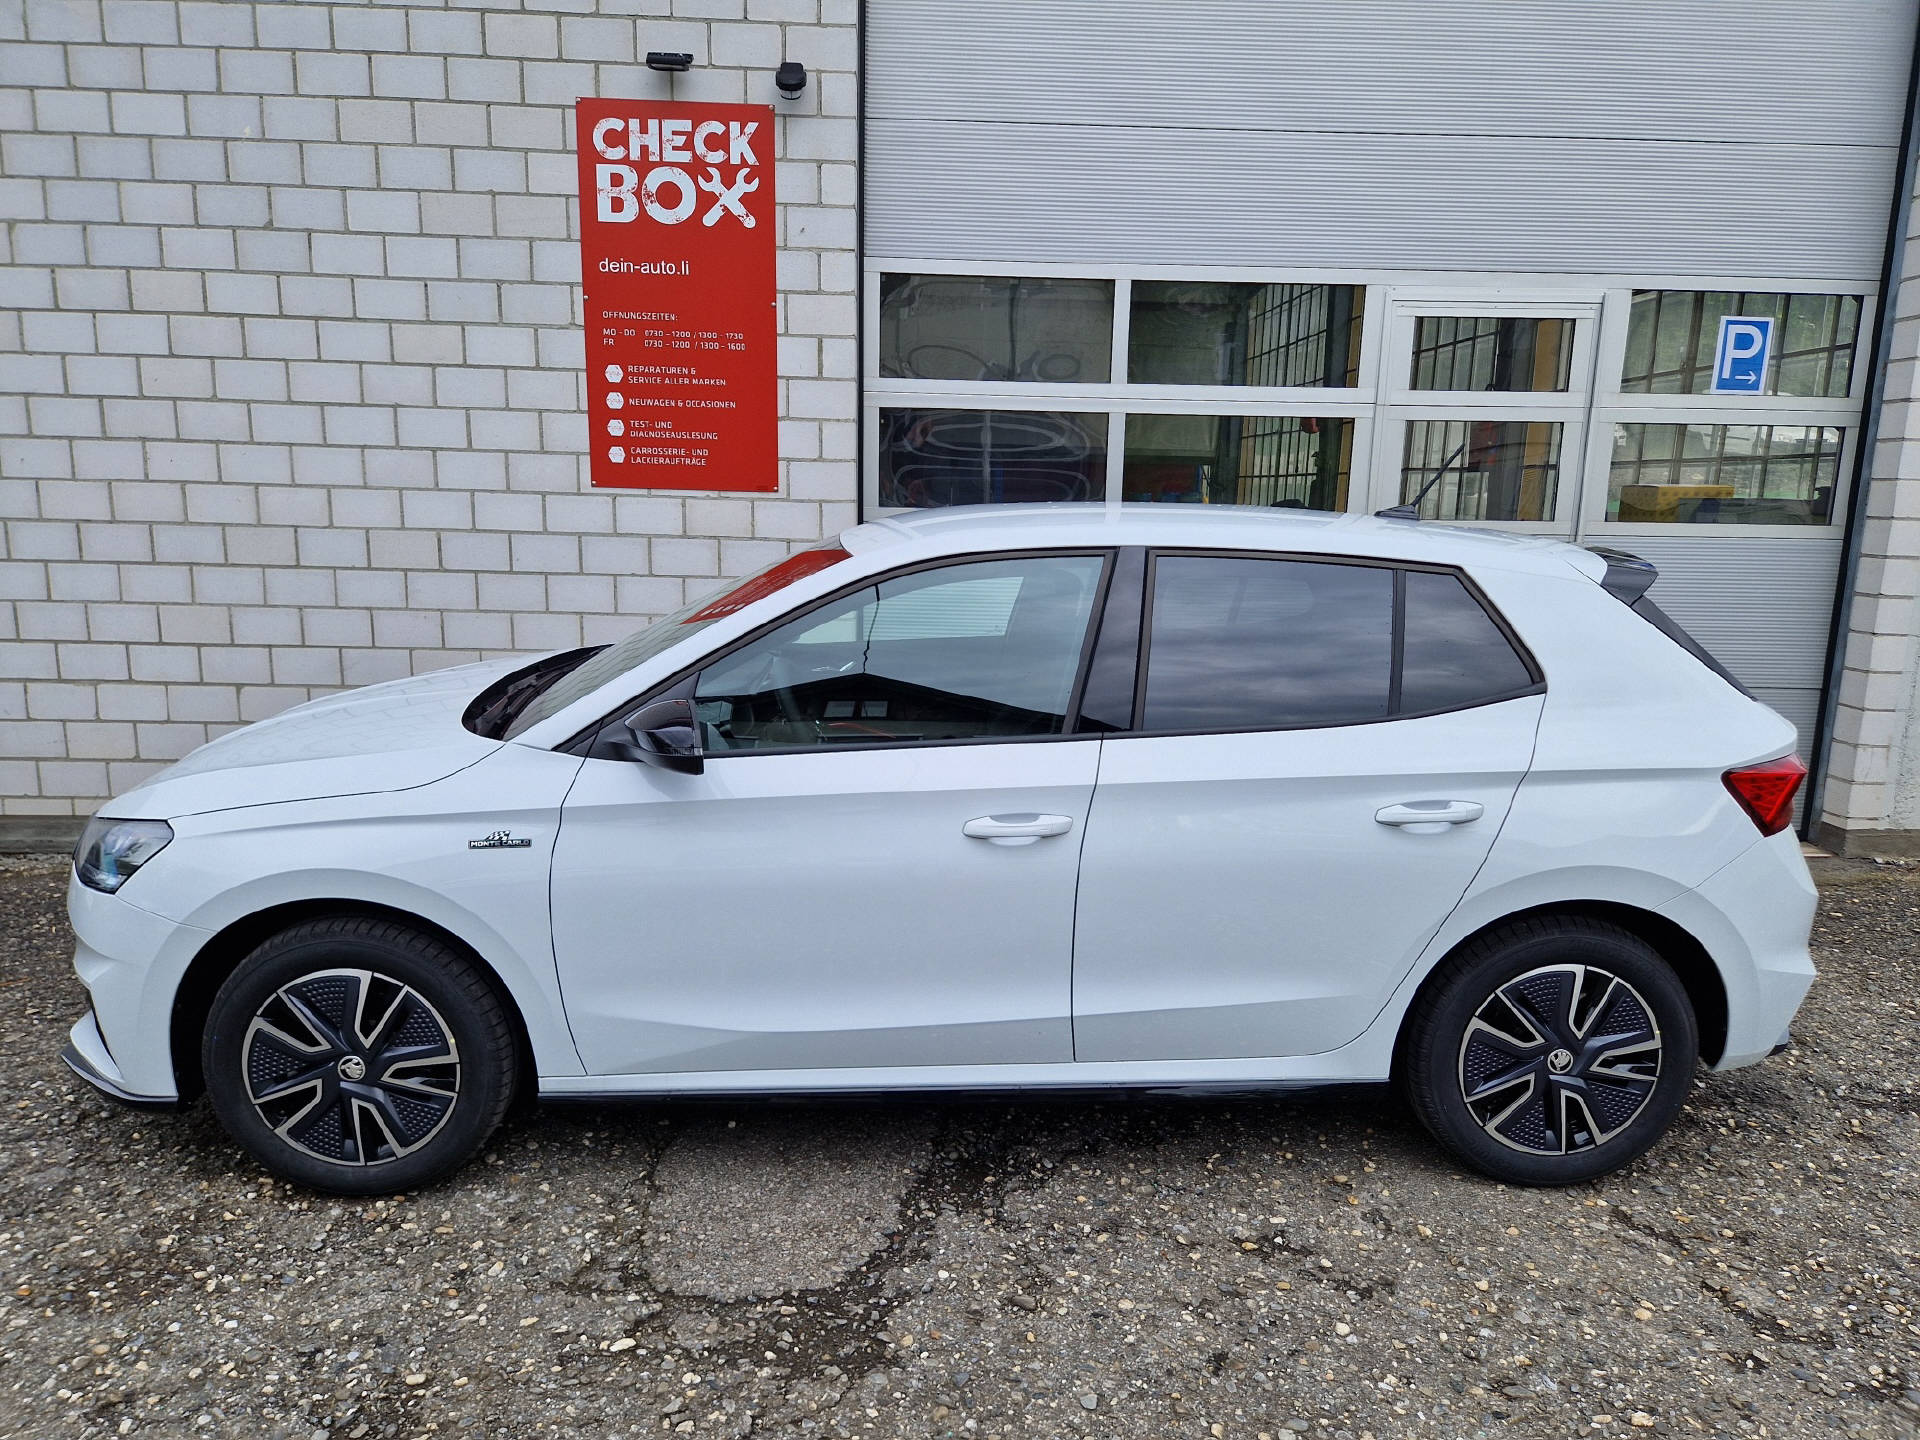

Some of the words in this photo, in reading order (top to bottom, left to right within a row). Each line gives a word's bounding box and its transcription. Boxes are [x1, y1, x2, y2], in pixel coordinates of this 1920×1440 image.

[592, 117, 760, 166] CHECK
[595, 163, 760, 229] BOX
[599, 258, 690, 276] dein-auto.li
[603, 328, 617, 336] MO
[671, 330, 691, 338] 1200
[698, 331, 718, 339] 1300
[725, 332, 744, 340] 1730
[603, 338, 615, 346] FR
[644, 339, 663, 348] 0730
[671, 340, 690, 349] 1200
[700, 341, 719, 350] 1300
[727, 342, 746, 351] 1600
[1721, 324, 1763, 379] P
[627, 365, 689, 375] REPARATUREN
[690, 367, 696, 375] &
[628, 376, 662, 385] SERVICE
[664, 377, 690, 385] ALLER
[692, 378, 727, 386] MARKEN
[629, 398, 675, 407] NEUWAGEN
[677, 399, 683, 407] &
[685, 399, 736, 408] OCCASIONEN
[629, 420, 653, 428] TEST-
[655, 421, 672, 429] UND
[630, 430, 718, 440] DIAGNOSEAUSLESUNG
[630, 447, 690, 456] CARROSSERIE-
[692, 448, 709, 456] UND
[631, 456, 707, 466] LACKIERAUFTRÄGE
